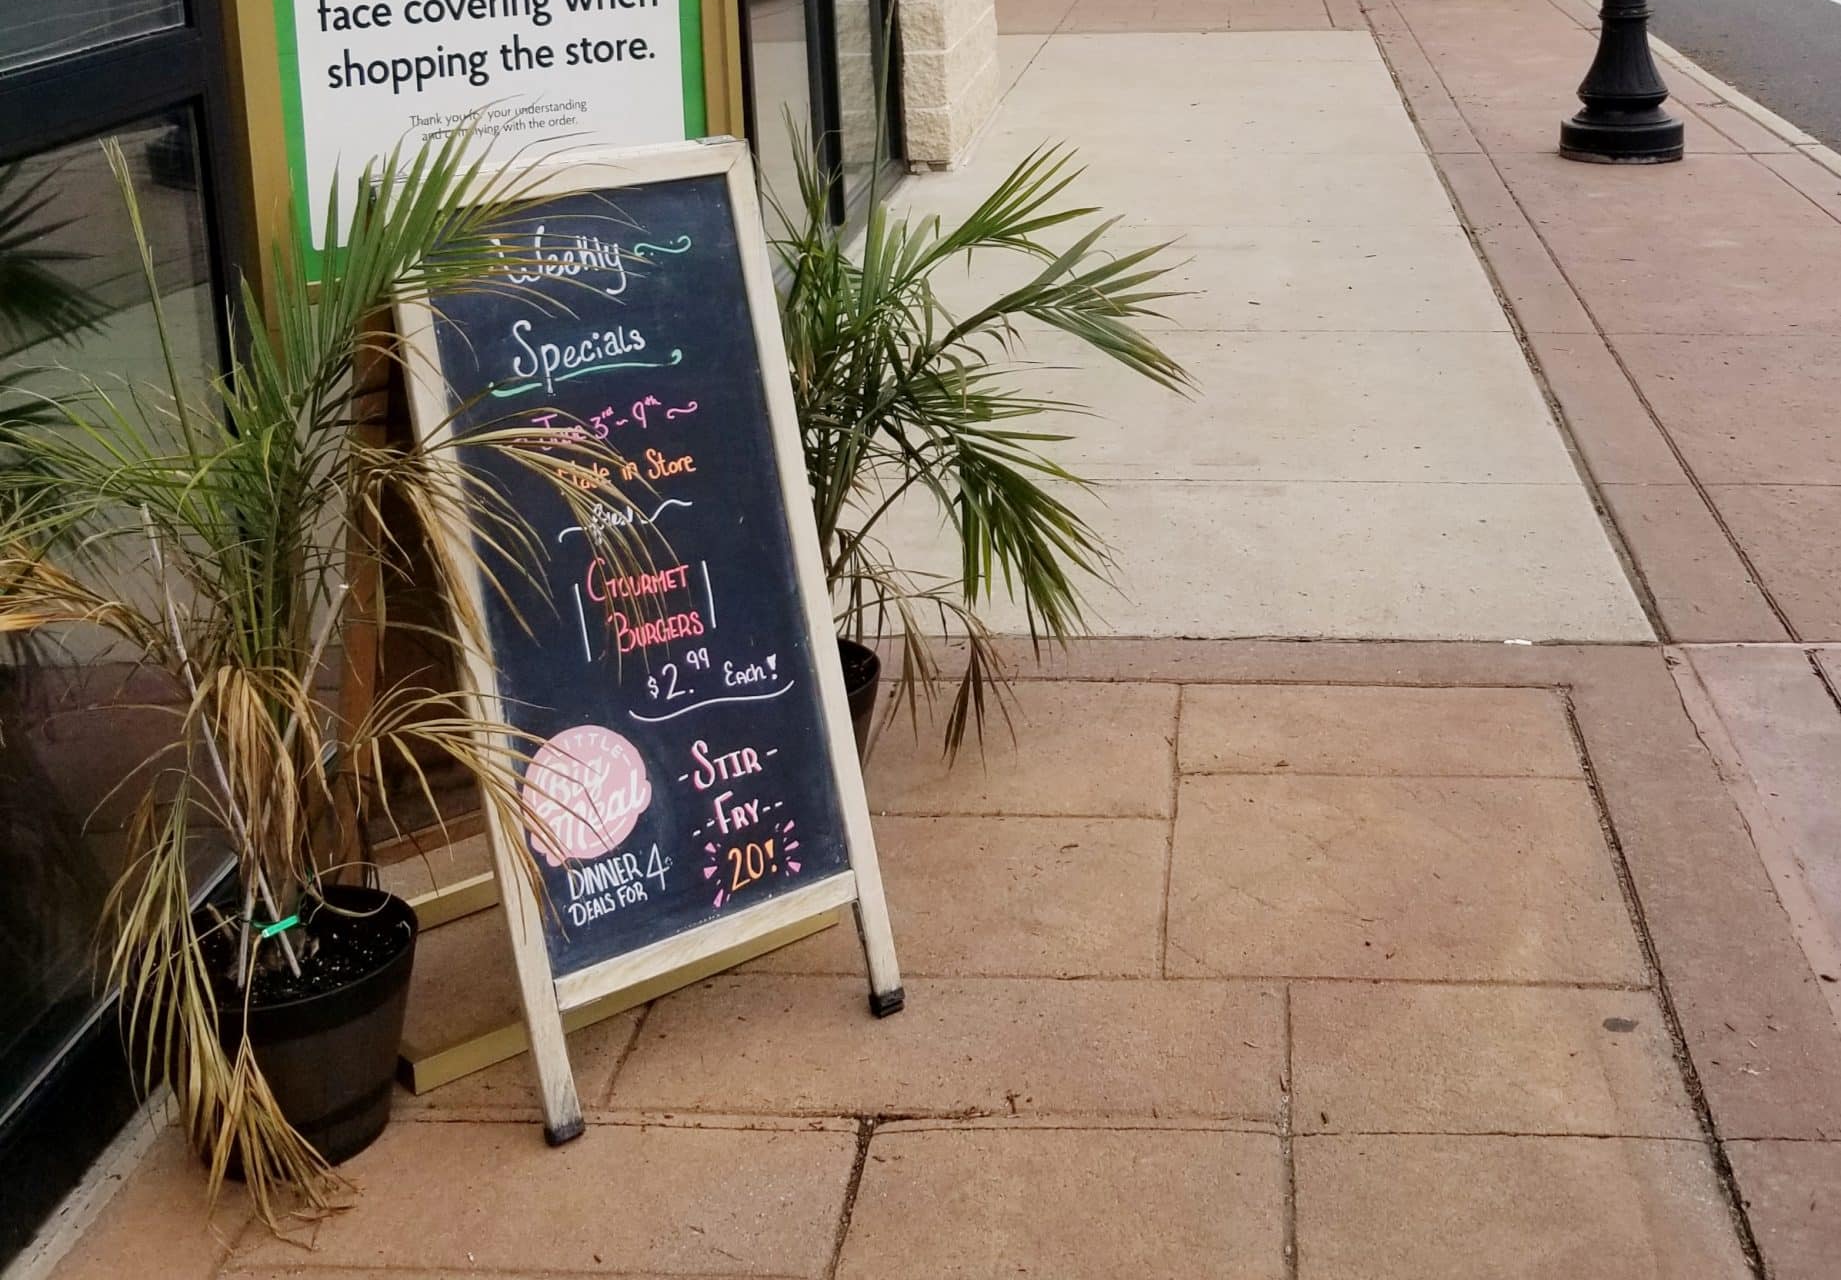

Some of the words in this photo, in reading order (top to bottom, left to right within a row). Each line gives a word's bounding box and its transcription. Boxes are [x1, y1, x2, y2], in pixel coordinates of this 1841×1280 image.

[327, 45, 490, 95] shopping
[499, 33, 555, 72] the
[565, 37, 655, 66] store.
[409, 113, 442, 128] Thank
[445, 114, 466, 126] you
[468, 108, 483, 121] fo
[487, 108, 511, 122] your
[515, 99, 588, 116] understanding
[422, 128, 441, 141] and
[503, 119, 526, 132] with
[528, 117, 546, 129] the
[548, 114, 578, 127] order.
[512, 319, 647, 395] Specials
[514, 413, 588, 449] Je
[646, 447, 697, 480] Store
[607, 611, 705, 653] BURGERS
[567, 852, 644, 901] DINNER
[727, 838, 778, 892] 20!
[567, 889, 616, 927] DEALS
[617, 881, 649, 908] FOR
